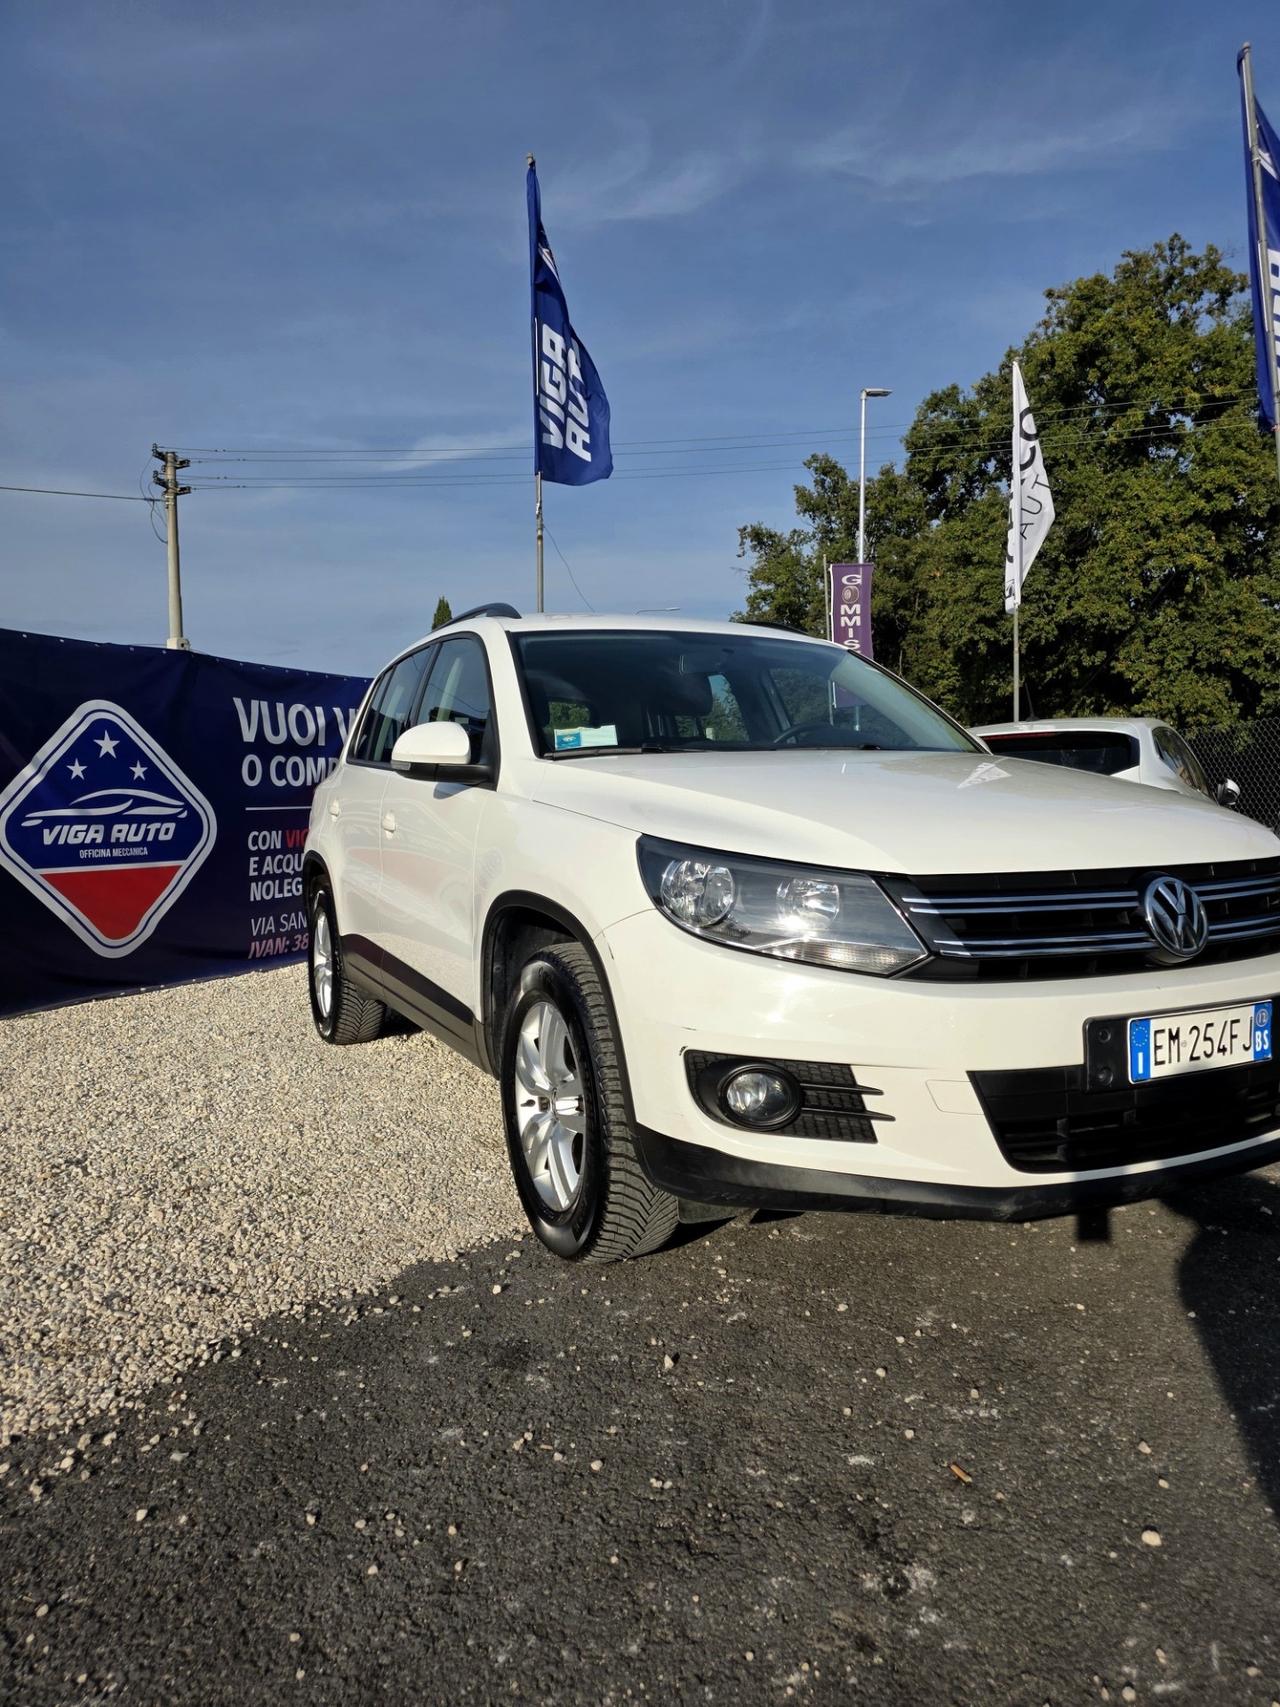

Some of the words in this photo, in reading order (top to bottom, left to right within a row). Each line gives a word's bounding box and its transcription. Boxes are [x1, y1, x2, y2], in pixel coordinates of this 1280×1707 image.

[540, 323, 567, 449] VIGA
[566, 337, 592, 462] AUT
[233, 697, 326, 746] VUOI
[242, 754, 262, 787] O
[43, 824, 104, 845] VIGA
[111, 823, 176, 843] AUTO
[248, 830, 282, 851] CON
[79, 848, 111, 859] OFFICINA
[113, 847, 148, 857] MECCANICA
[249, 856, 260, 876] E
[250, 877, 303, 901] NOLEG
[251, 916, 275, 937] VIA
[280, 911, 307, 932] SAN
[1255, 1029, 1269, 1052] BS
